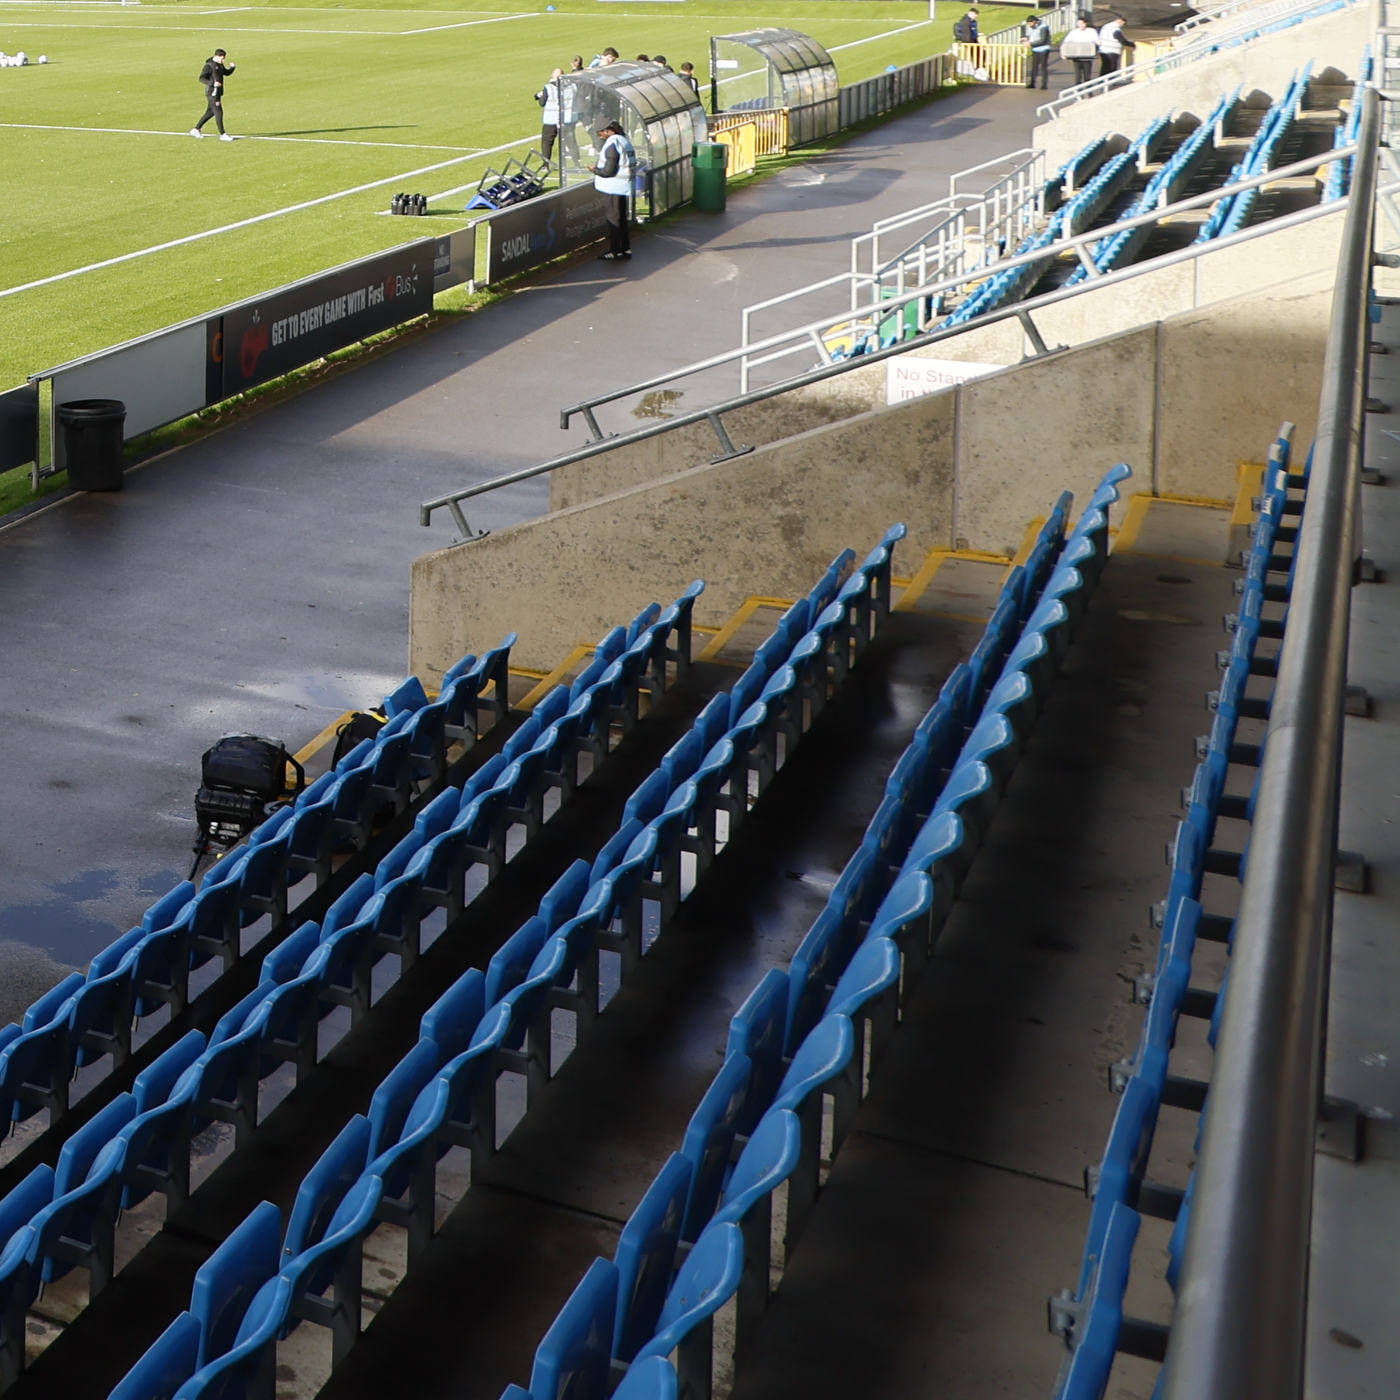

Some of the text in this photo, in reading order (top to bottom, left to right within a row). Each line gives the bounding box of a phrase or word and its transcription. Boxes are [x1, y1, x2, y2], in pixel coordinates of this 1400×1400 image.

[501, 233, 530, 262] SANDAL
[272, 275, 411, 346] GET TO EVERY GAME WITH First Bus
[896, 368, 966, 385] No Stan
[901, 386, 915, 400] in
